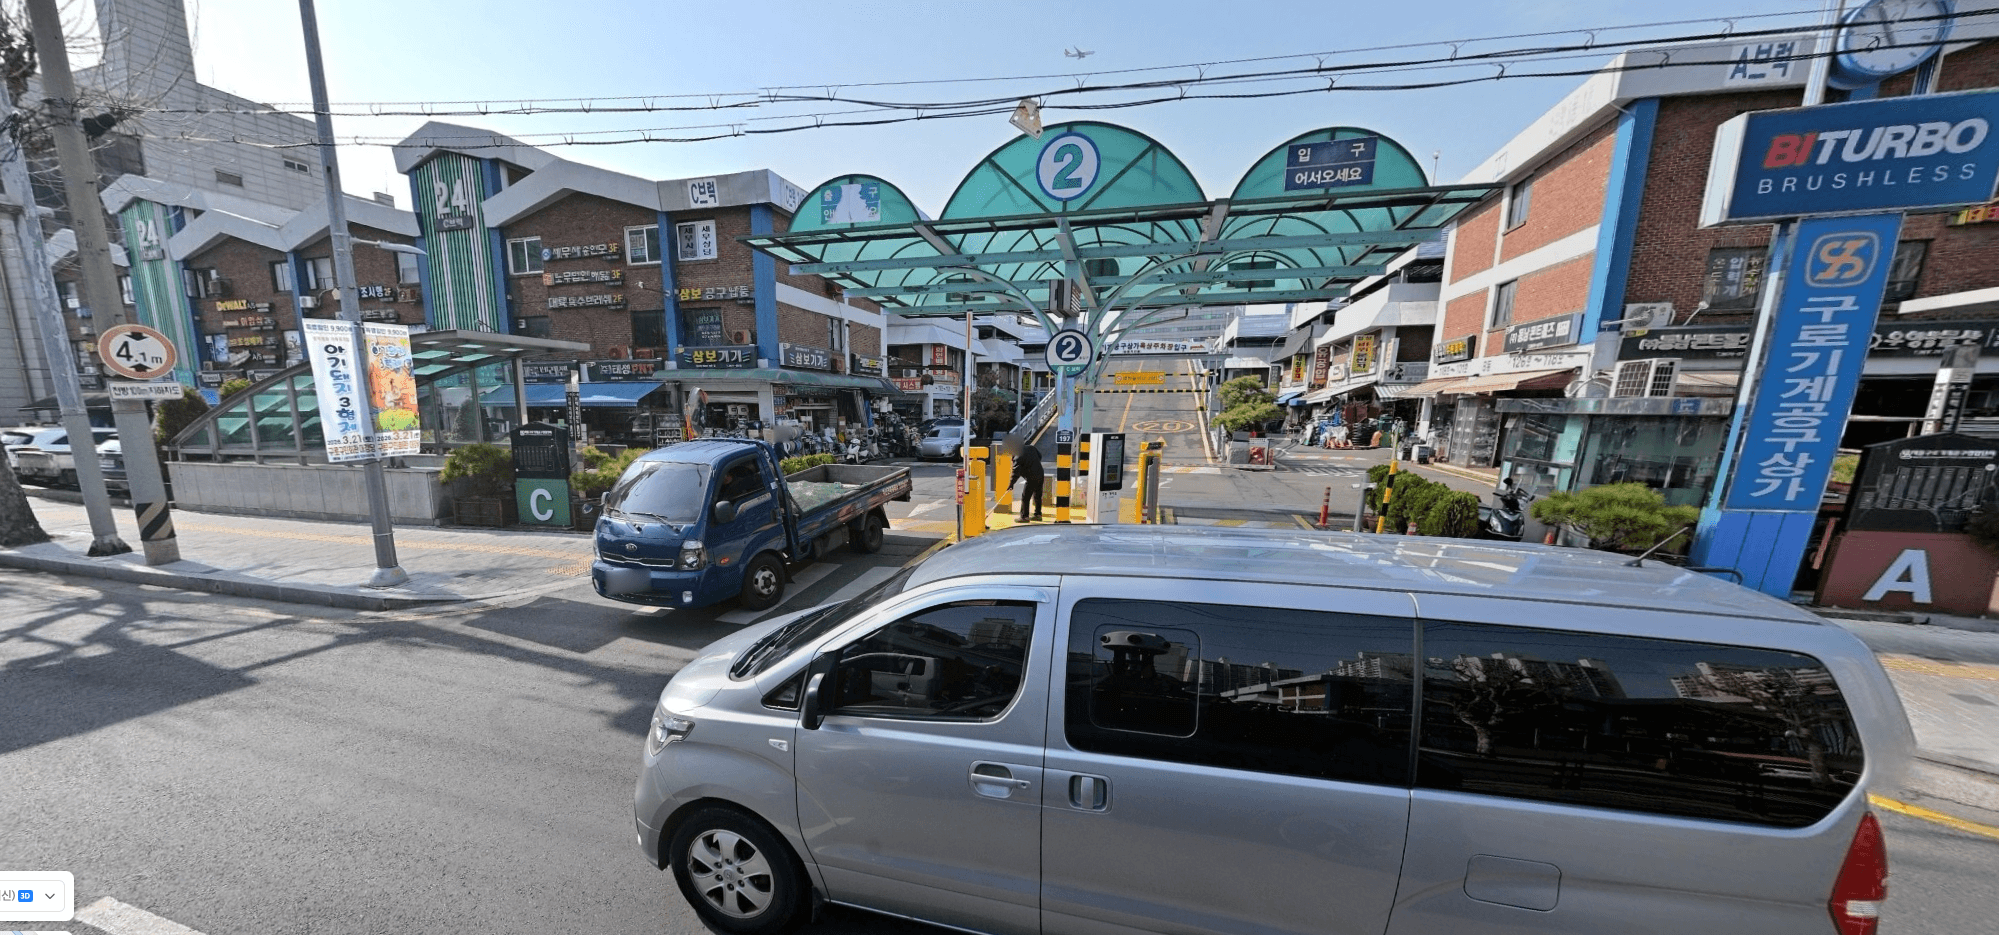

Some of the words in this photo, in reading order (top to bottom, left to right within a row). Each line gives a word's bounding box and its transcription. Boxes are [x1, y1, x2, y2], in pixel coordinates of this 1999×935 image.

[1729, 42, 1797, 81] A브럭
[1763, 117, 1990, 169] BITURBO
[1053, 144, 1083, 190] 2
[1294, 165, 1363, 186] 어서오세요
[1757, 163, 1976, 194] BRUSHLESS
[435, 179, 467, 214] 24
[691, 181, 717, 205] C브럭
[135, 220, 159, 246] 24
[608, 242, 618, 253] 3F
[611, 269, 622, 279] 3F
[680, 288, 702, 300] 삼보
[705, 286, 727, 299] 공구
[728, 285, 750, 298] 납품
[216, 299, 248, 311] DeWALT
[693, 349, 742, 363] 삼보기기
[795, 352, 825, 366] 삼보기기
[1061, 337, 1077, 359] 2
[1749, 295, 1860, 501] 구로기계공구상가
[1059, 434, 1071, 442] 197
[530, 488, 554, 521] C
[1862, 548, 1933, 603] A
